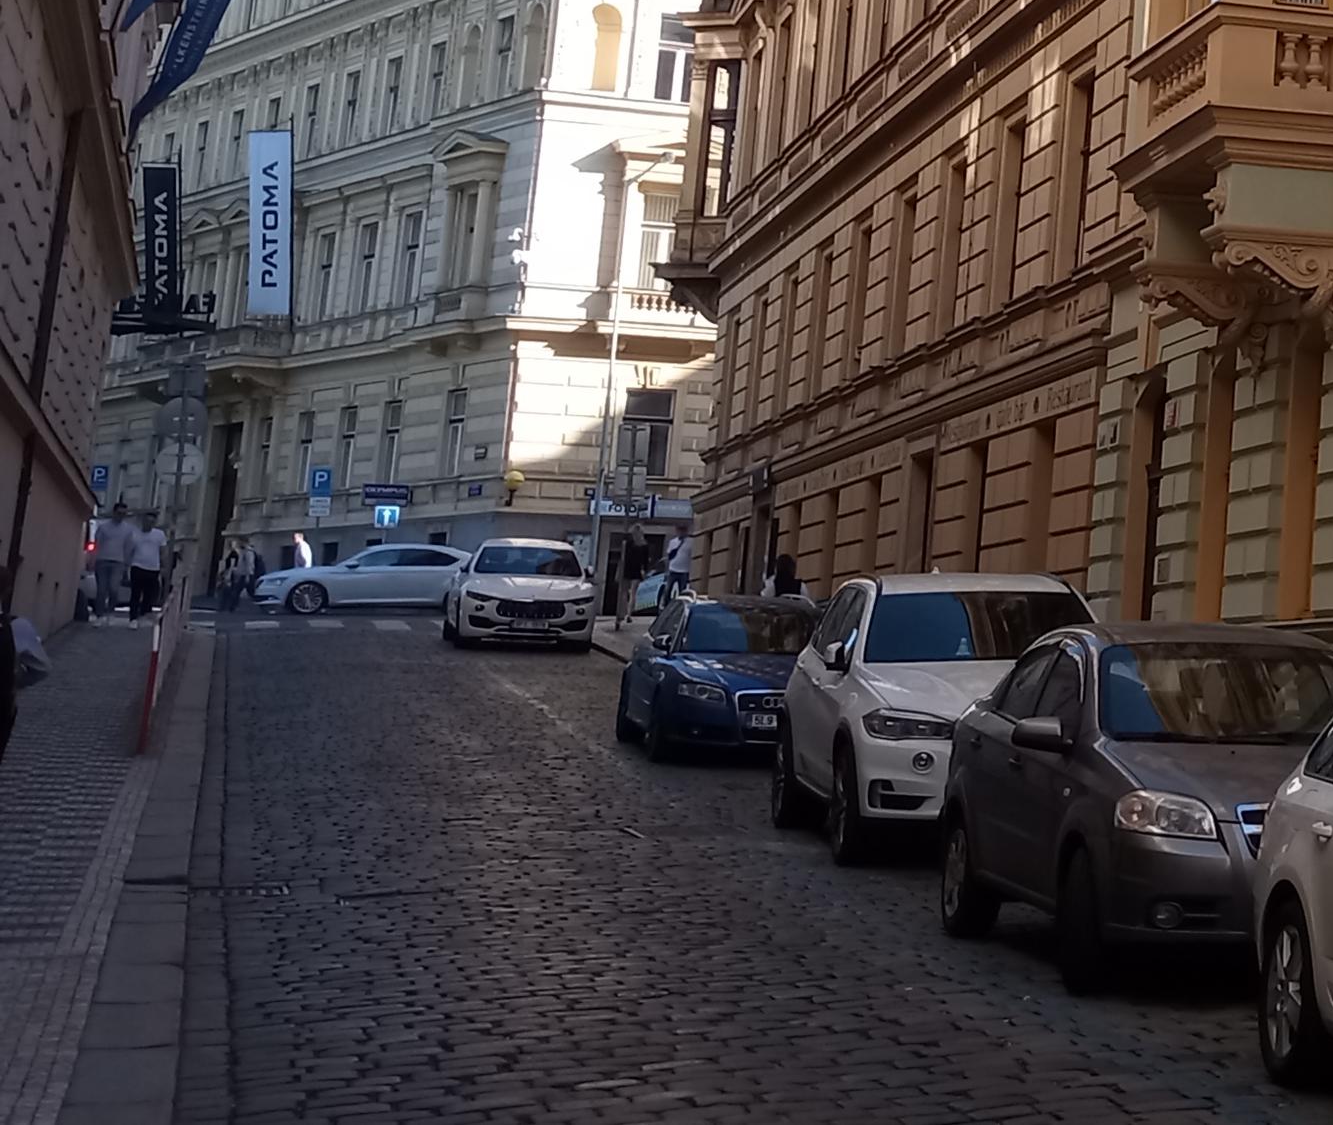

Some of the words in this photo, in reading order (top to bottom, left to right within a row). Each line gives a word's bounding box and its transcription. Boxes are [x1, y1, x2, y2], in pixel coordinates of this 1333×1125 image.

[153, 191, 169, 306] ATOMA
[261, 161, 279, 288] PATOMA
[314, 471, 328, 488] P
